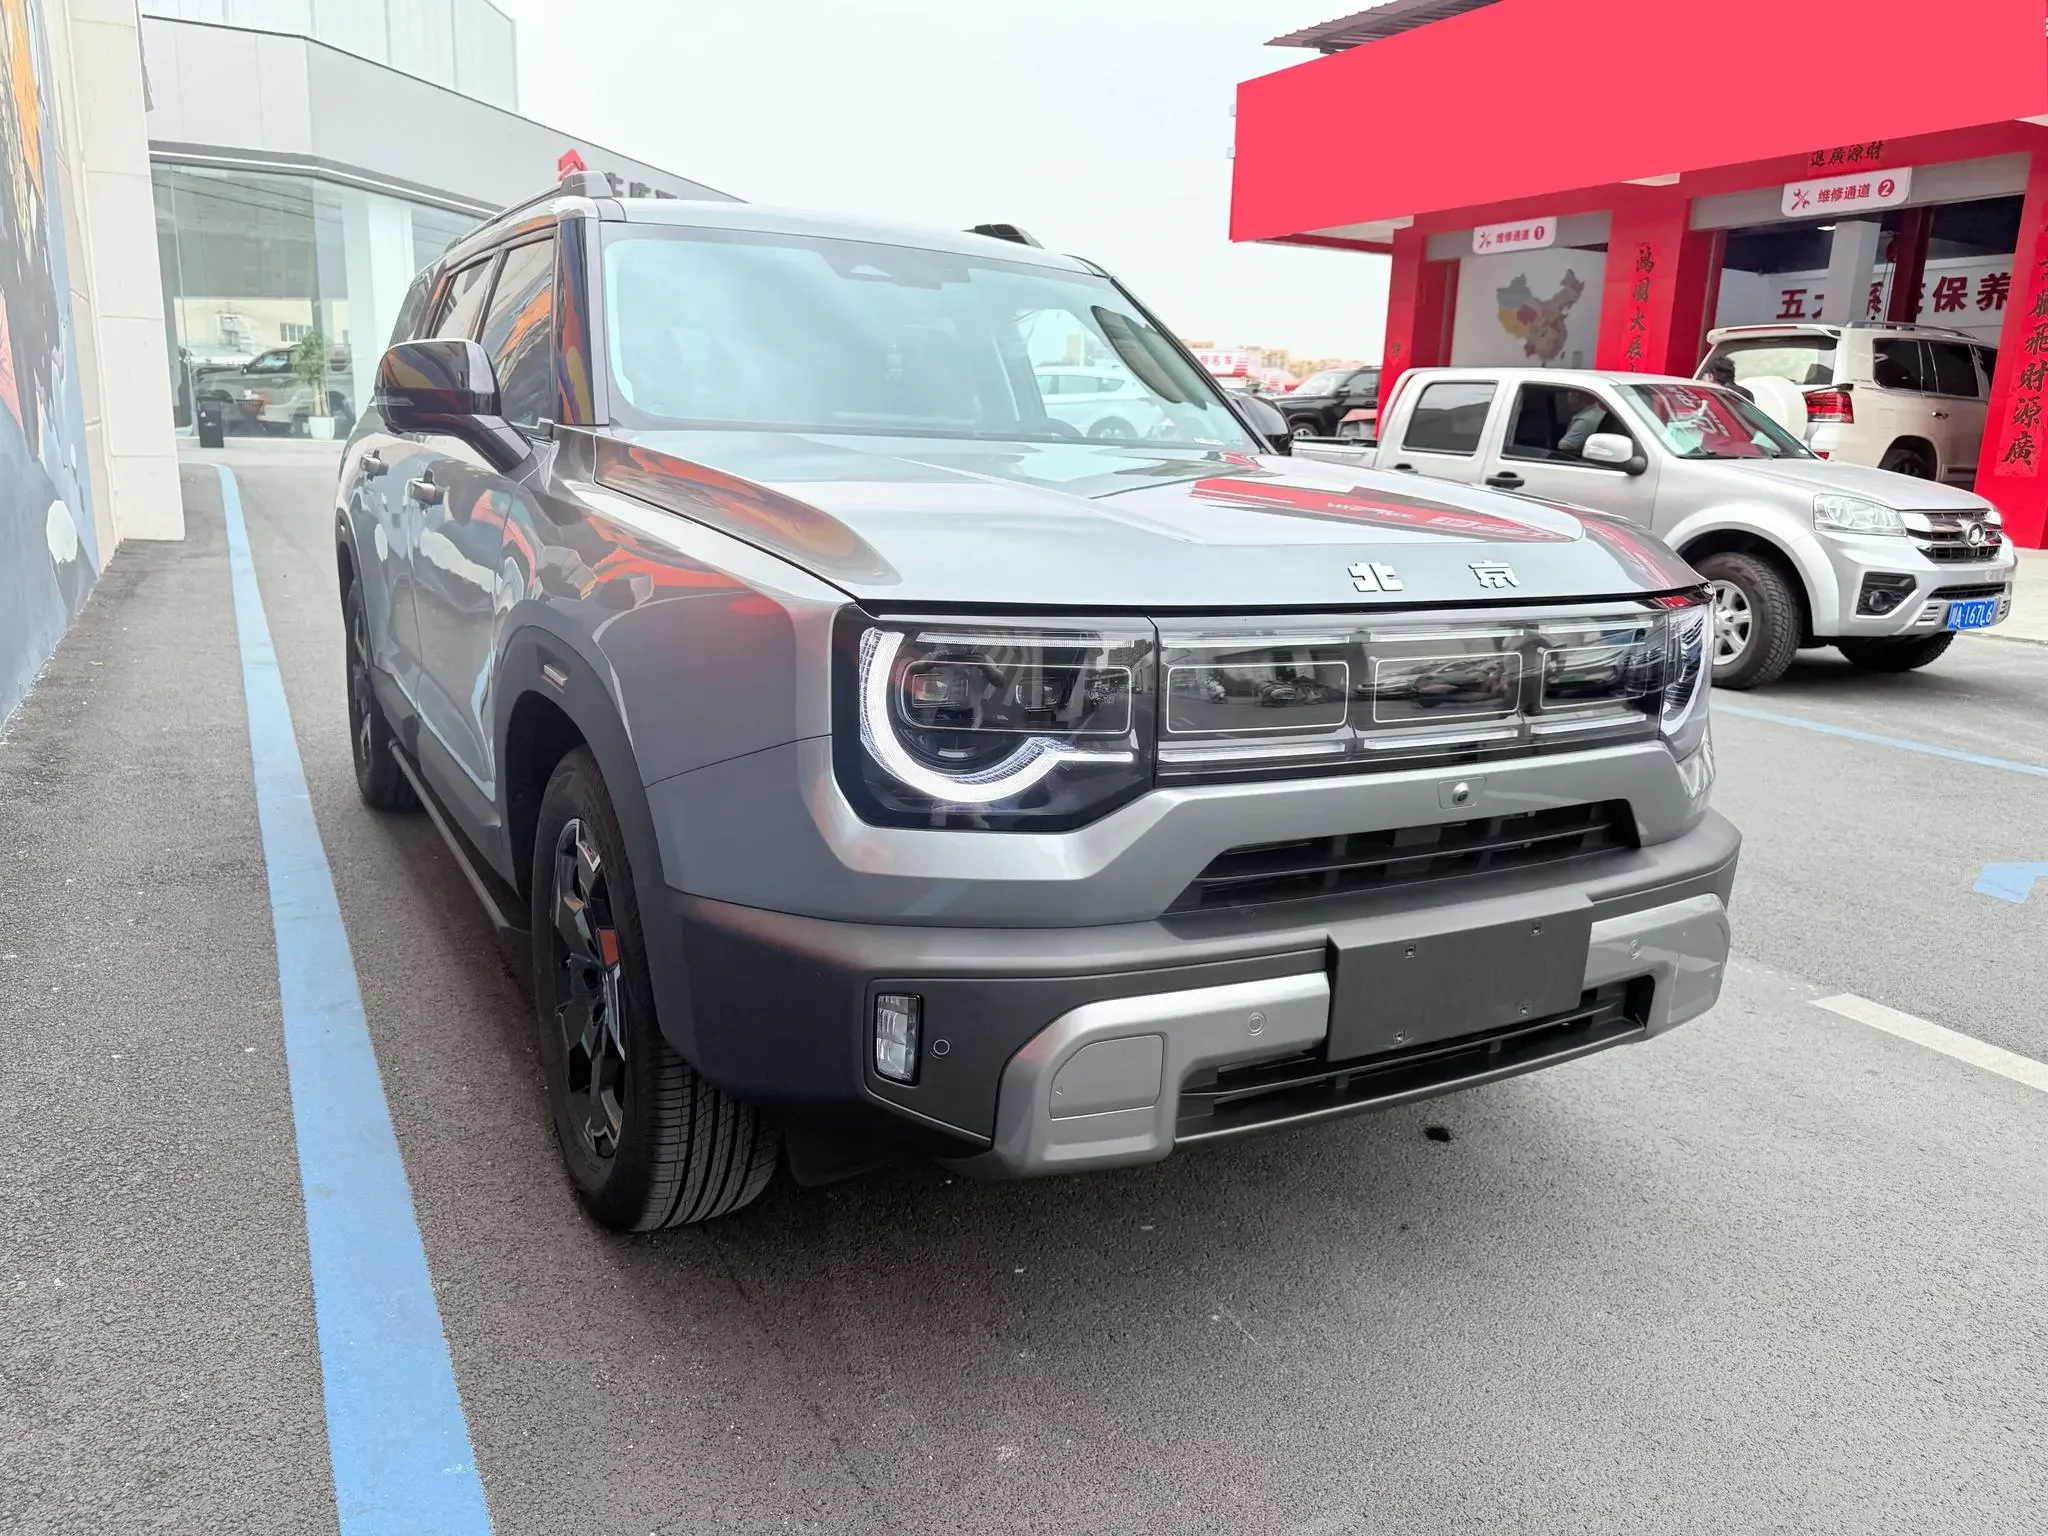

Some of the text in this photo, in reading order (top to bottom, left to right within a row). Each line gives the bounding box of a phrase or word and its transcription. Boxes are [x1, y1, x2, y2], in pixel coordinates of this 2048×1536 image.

[1817, 183, 1871, 203] 维修通道
[1348, 560, 1521, 593] 北京
